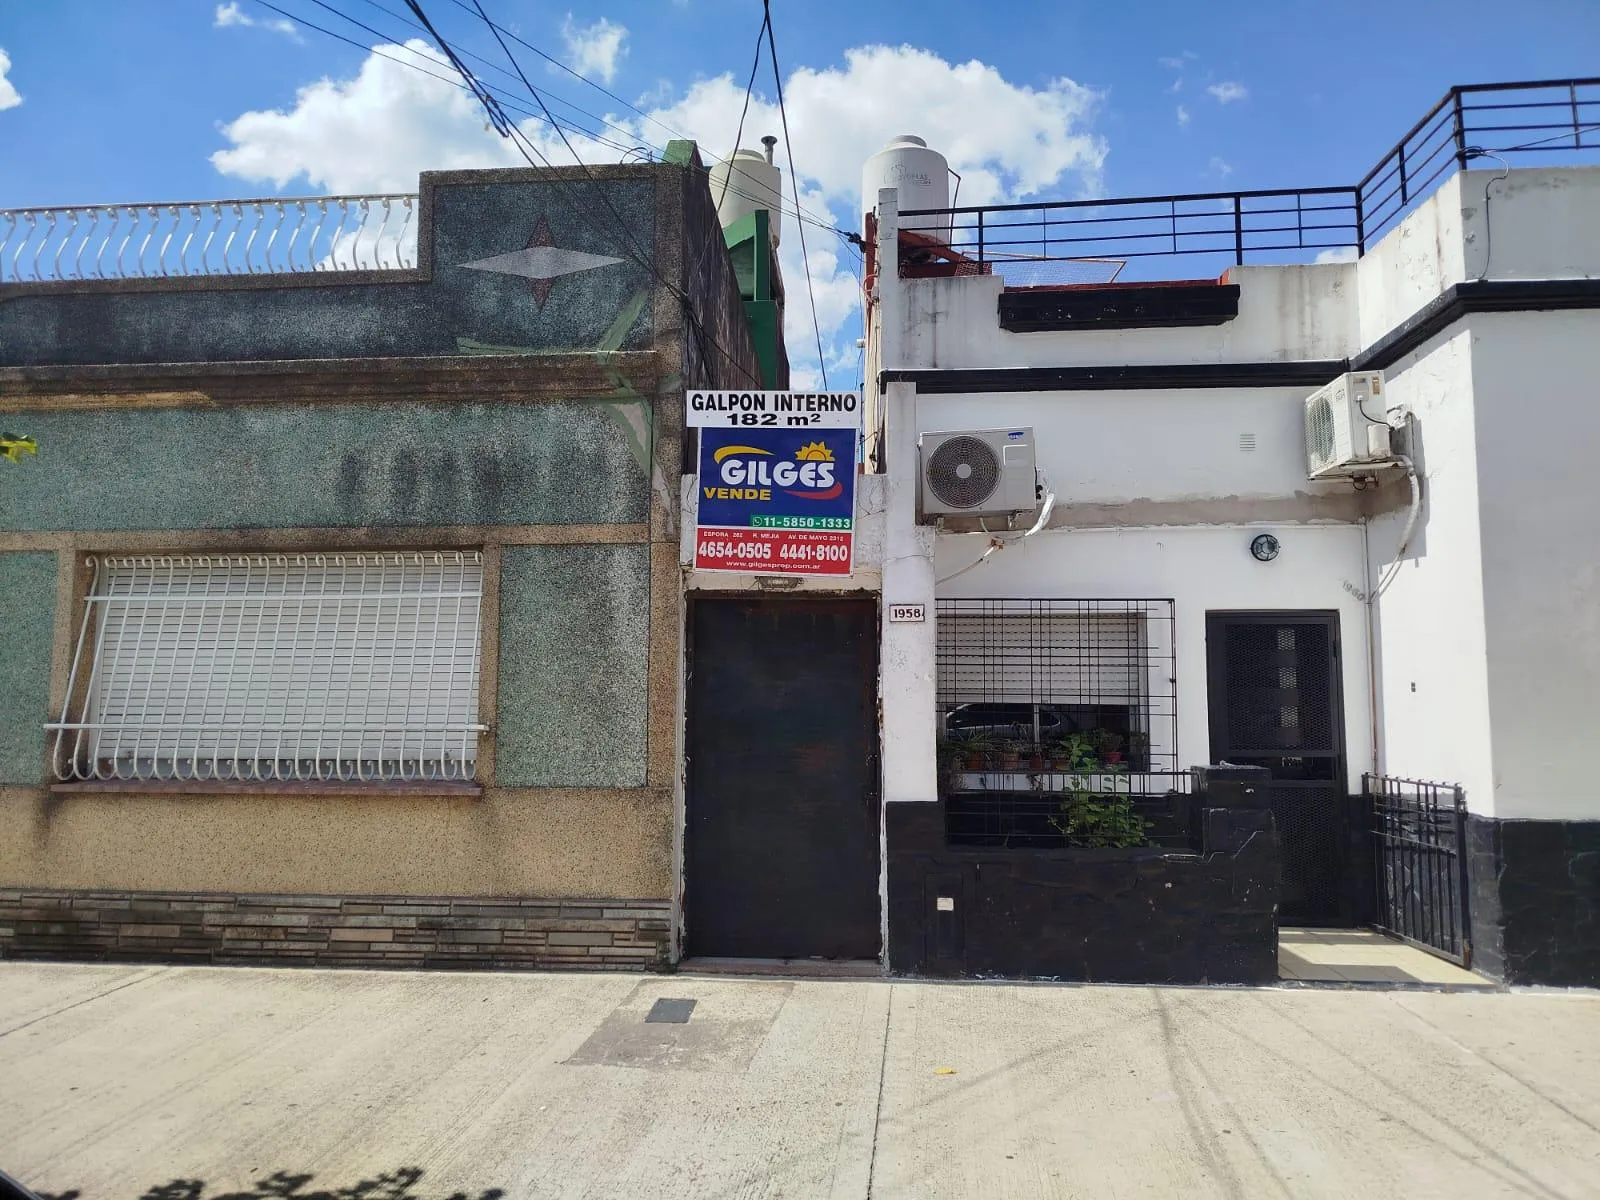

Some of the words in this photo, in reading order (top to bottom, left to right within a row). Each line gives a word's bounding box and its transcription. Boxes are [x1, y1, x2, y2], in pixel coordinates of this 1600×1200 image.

[691, 393, 766, 411] GALPON
[774, 394, 857, 412] INTERNO
[727, 413, 778, 426] 182
[720, 459, 835, 488] GILGES
[703, 487, 771, 501] VENDE
[763, 517, 851, 529] 11-5850-1333
[698, 541, 772, 559] 4654-0505
[779, 543, 848, 561] 4441-8100
[726, 560, 821, 569] www.gilgesprop.com.ar
[893, 608, 921, 619] 1958
